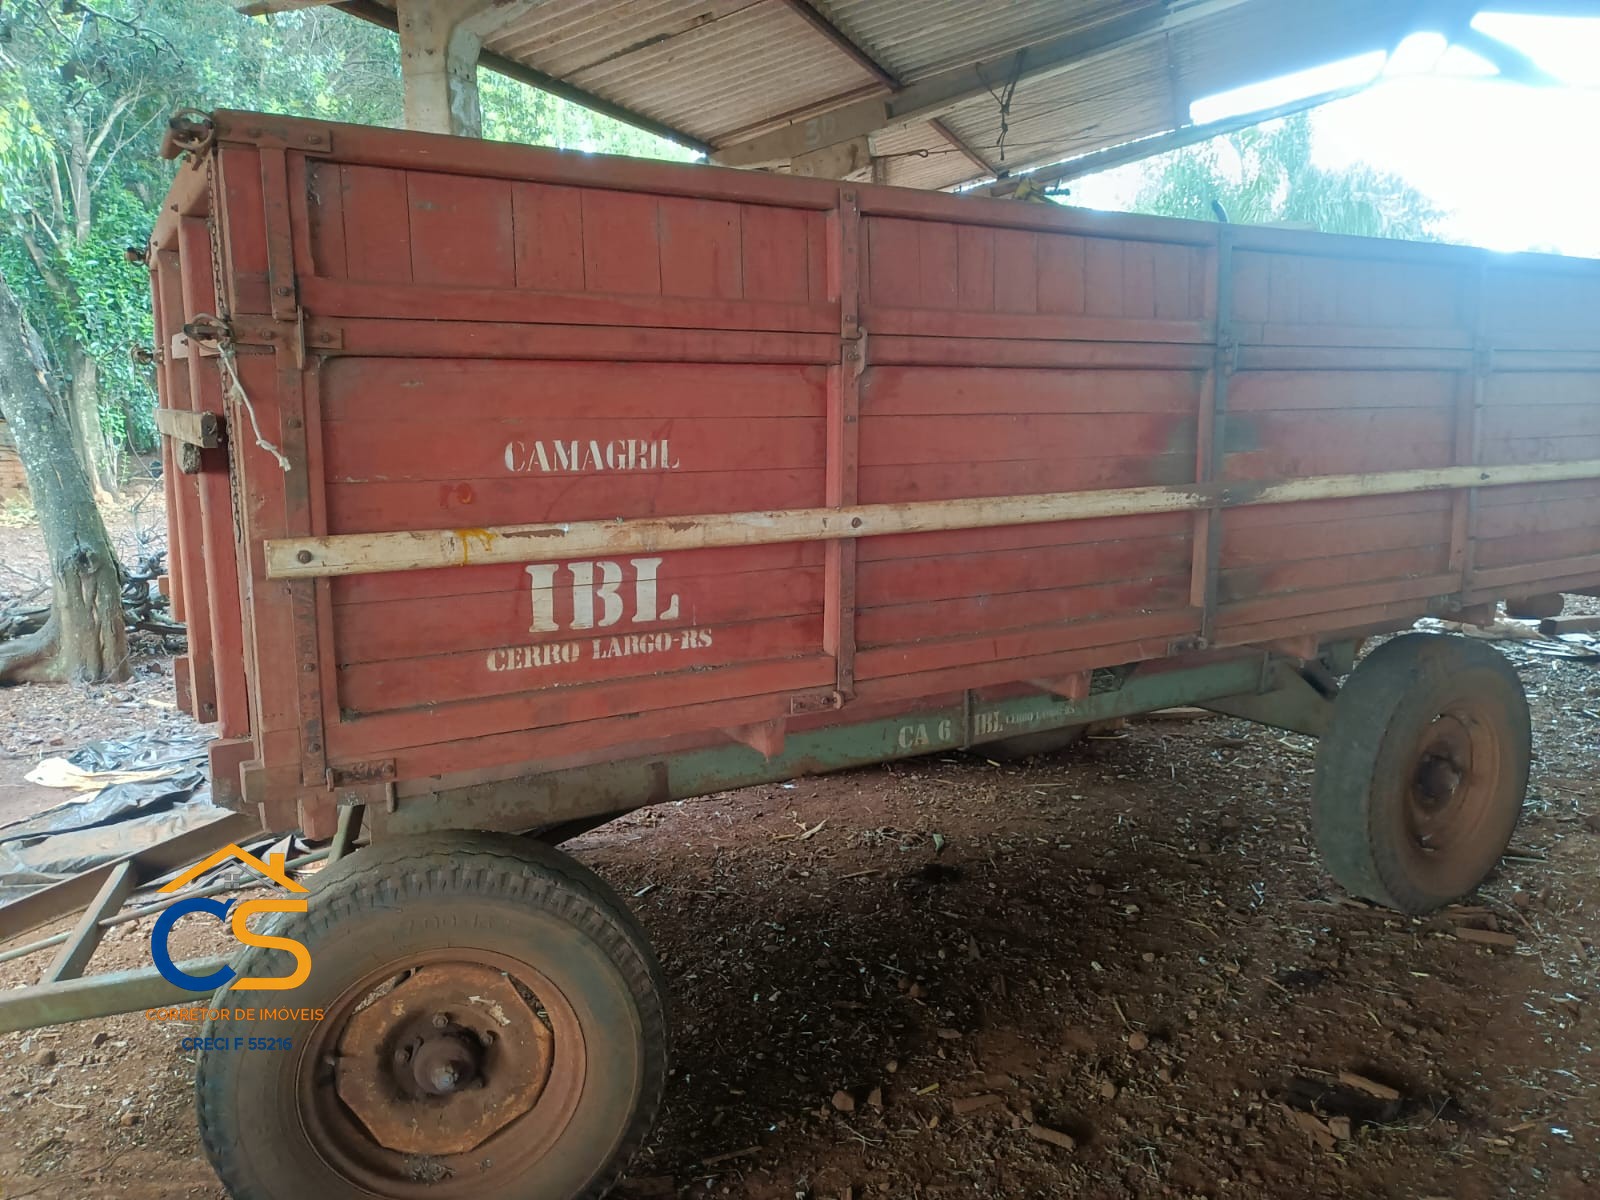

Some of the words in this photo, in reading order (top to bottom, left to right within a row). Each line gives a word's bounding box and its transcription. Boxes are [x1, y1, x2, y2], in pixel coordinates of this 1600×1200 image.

[504, 439, 680, 473] CAMAGRIL
[525, 557, 679, 633] IBL
[486, 643, 580, 672] CERRO
[592, 628, 713, 660] LARGO-RS
[898, 724, 930, 748] CA
[975, 711, 1004, 736] IBL
